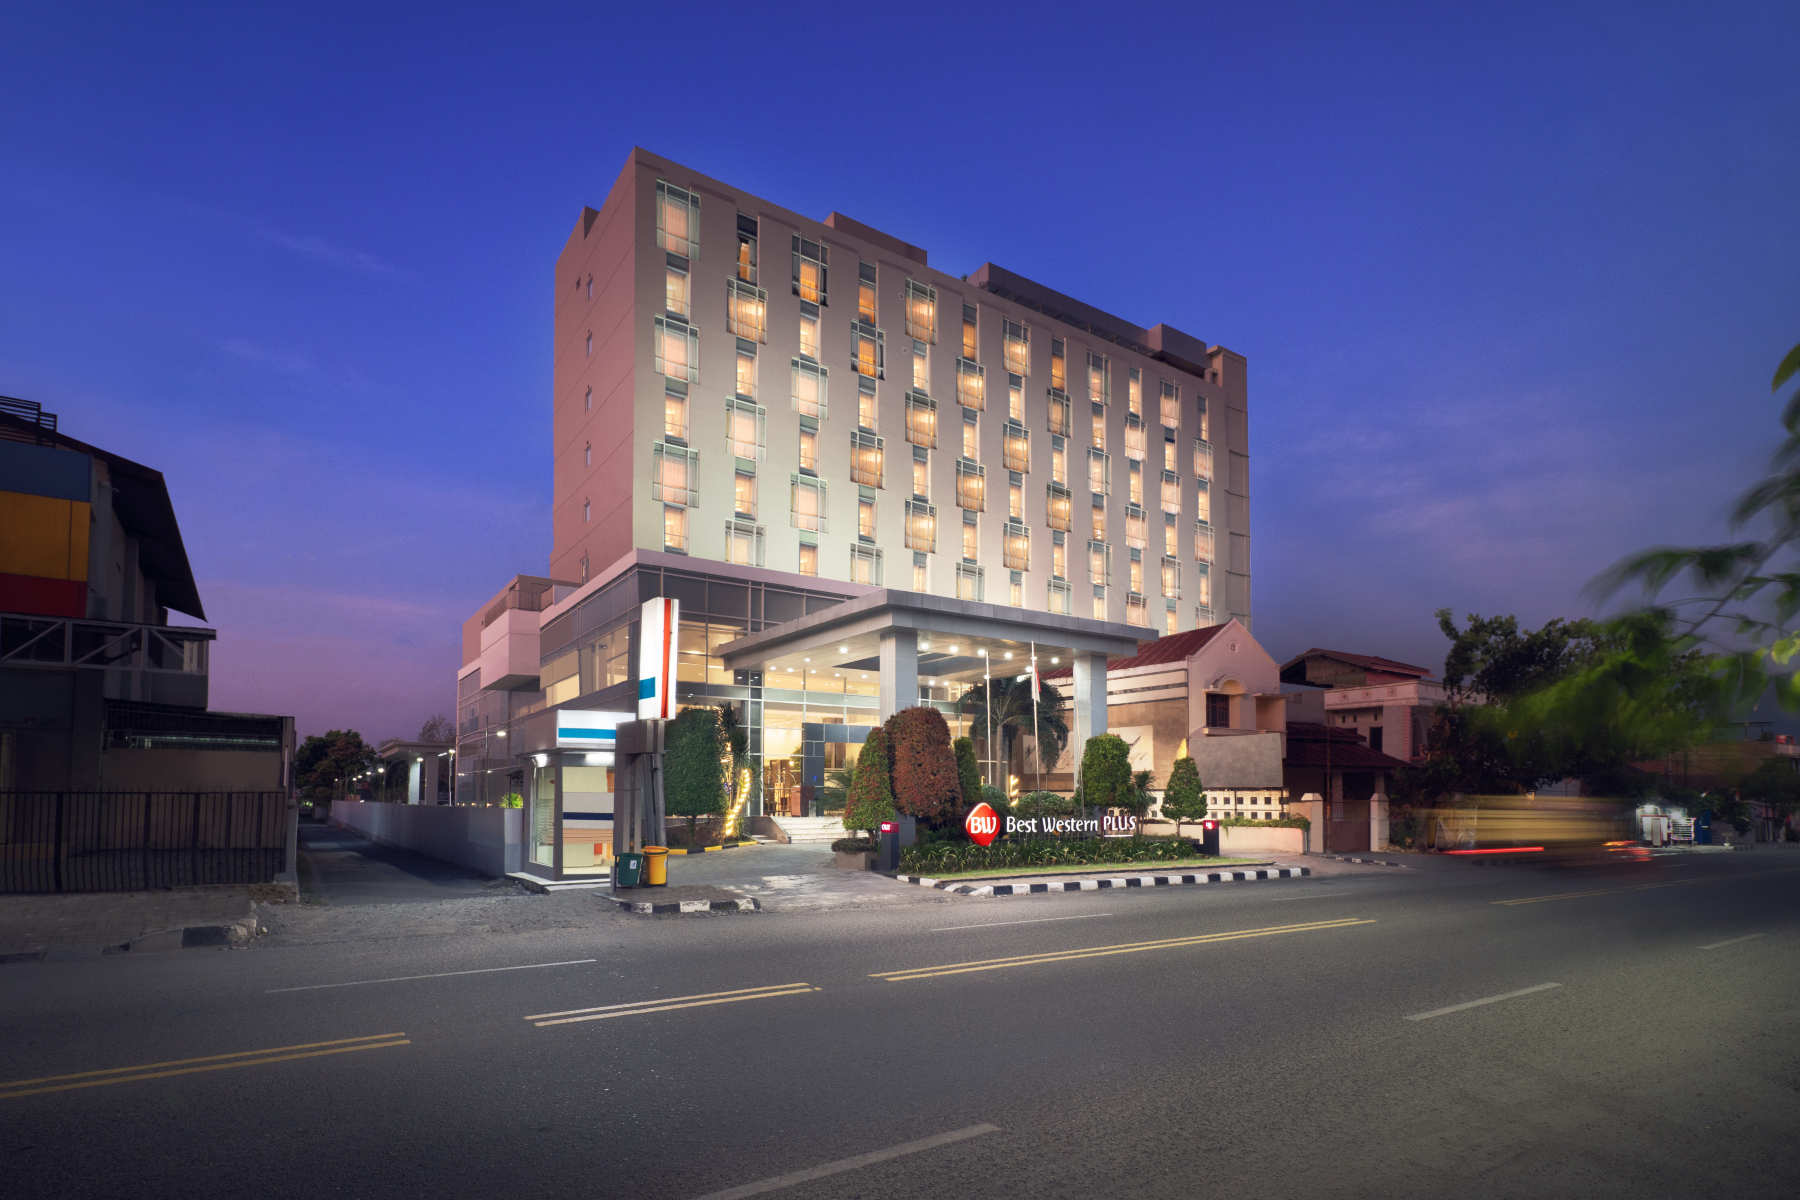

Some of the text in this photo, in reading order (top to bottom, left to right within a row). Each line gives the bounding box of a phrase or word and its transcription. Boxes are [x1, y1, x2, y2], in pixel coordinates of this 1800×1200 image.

[970, 816, 997, 834] BW
[1006, 815, 1136, 833] Best Western PLUS
